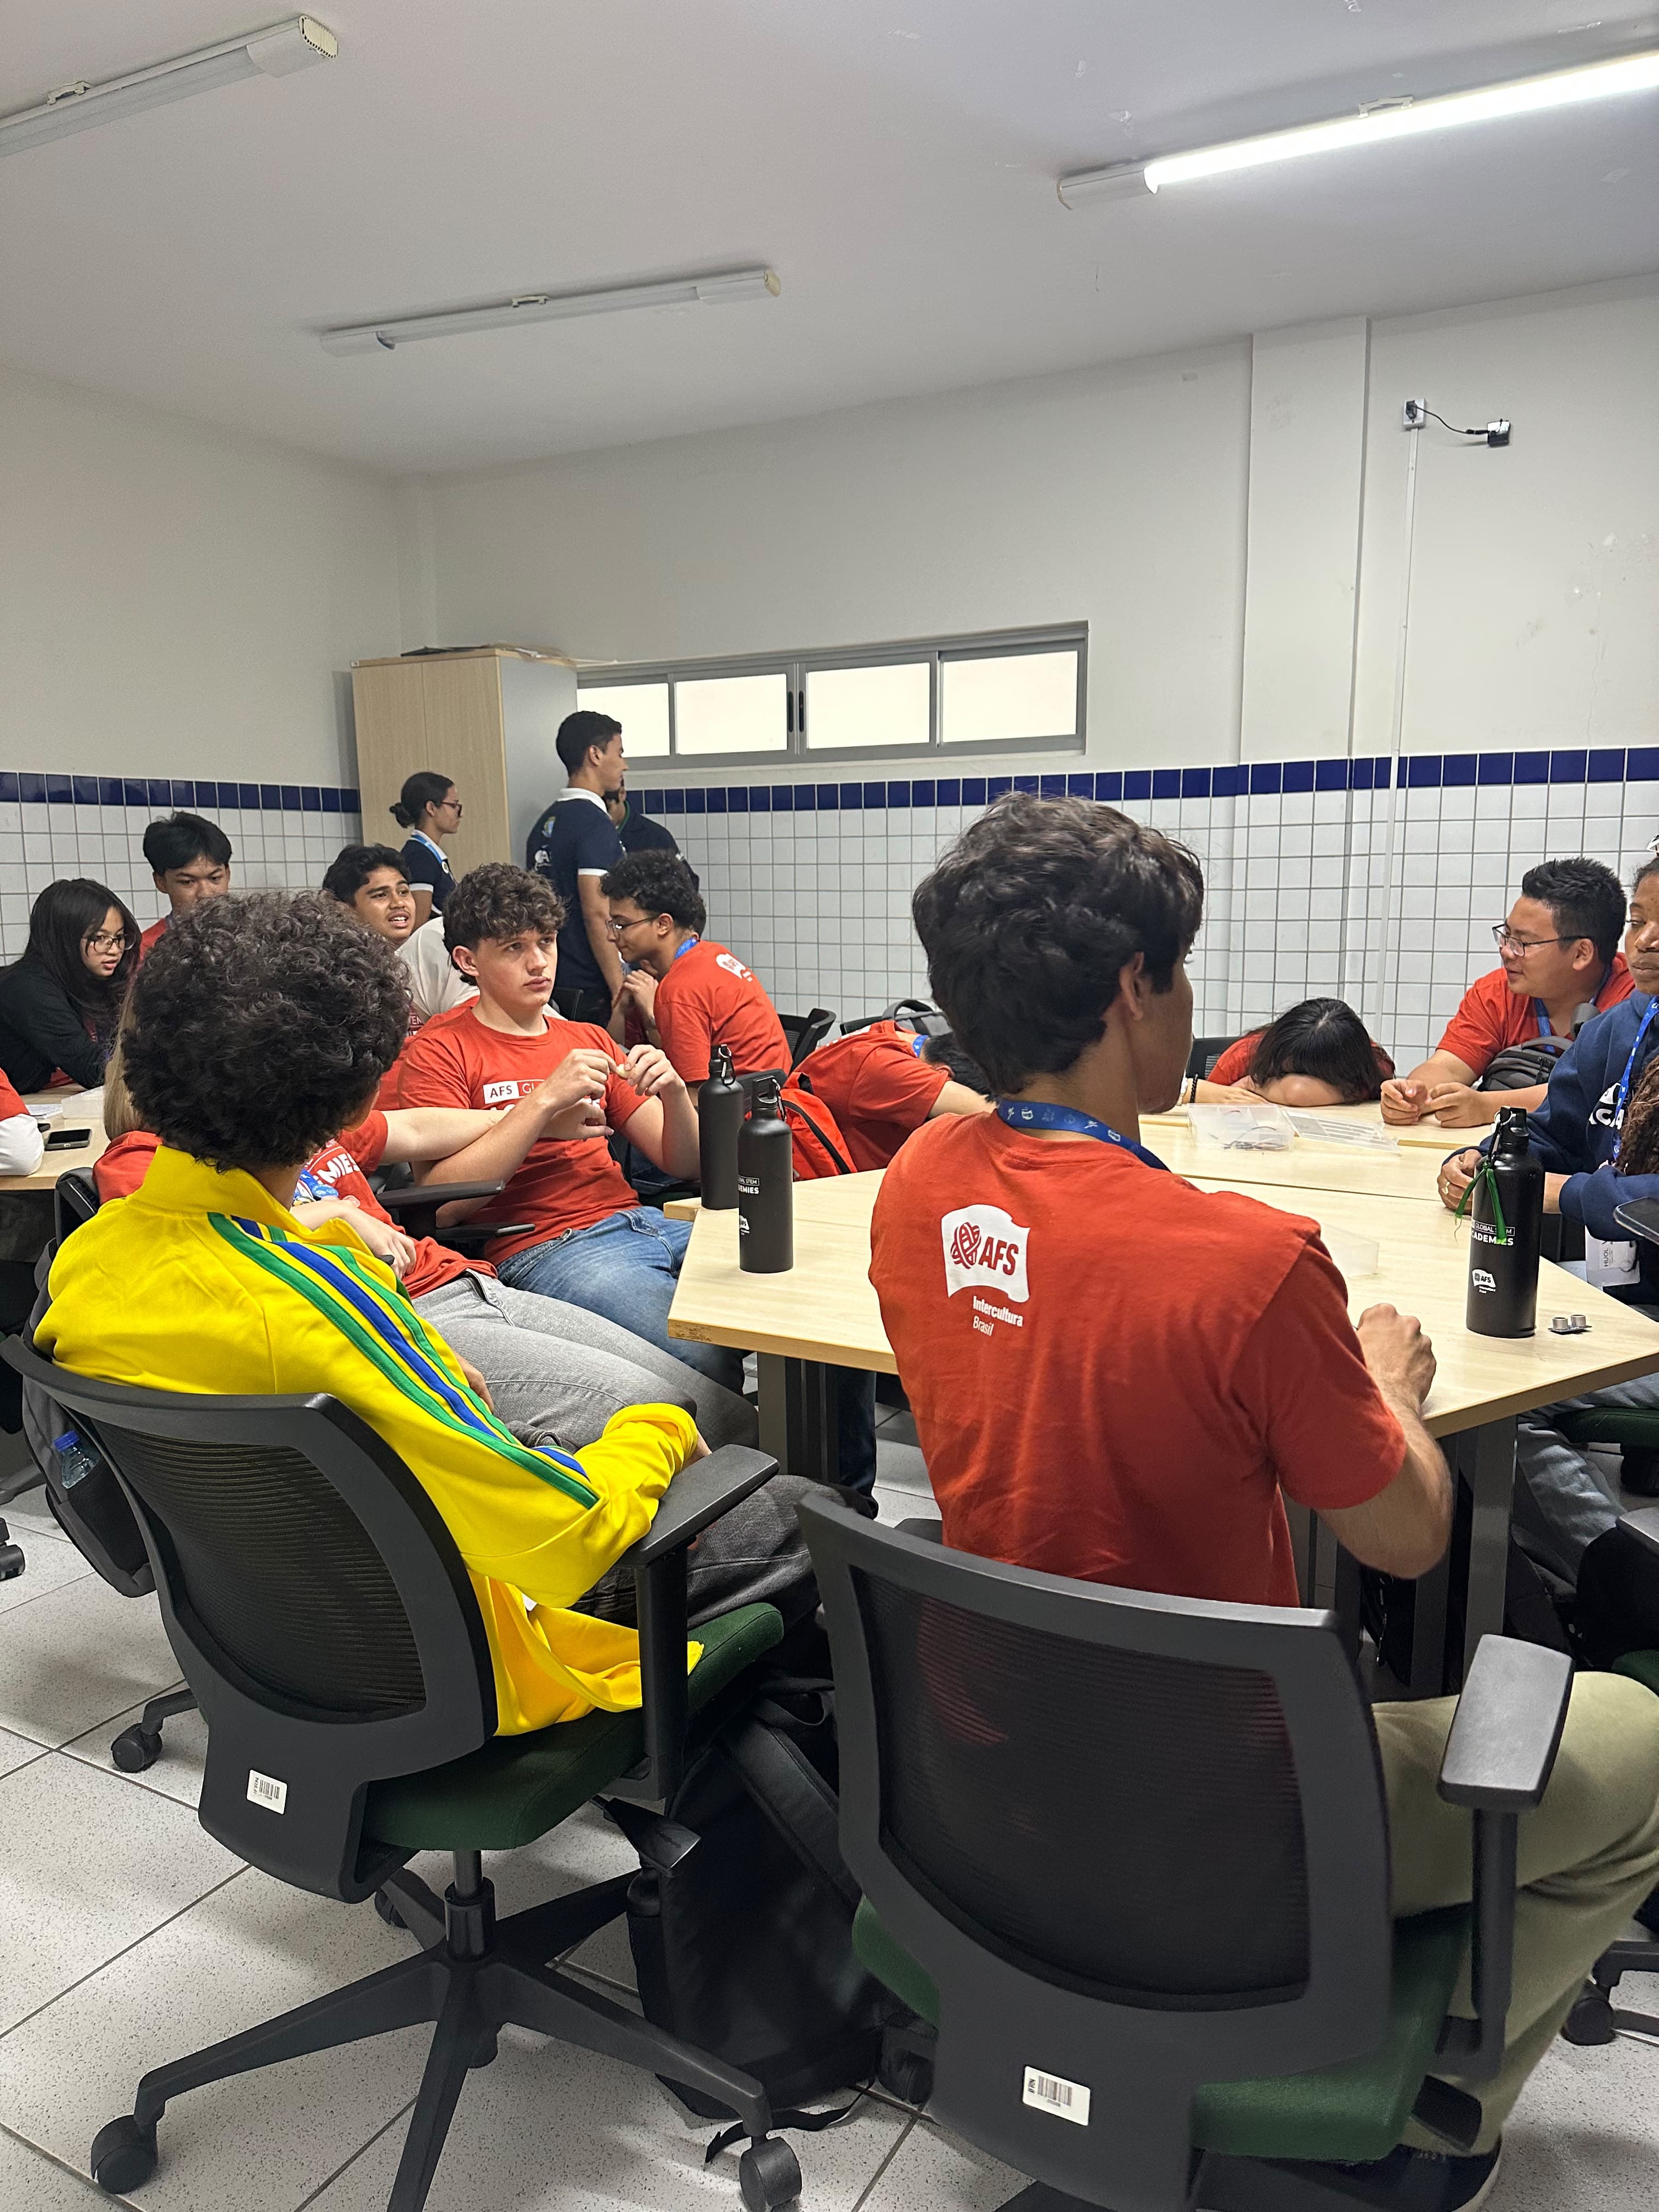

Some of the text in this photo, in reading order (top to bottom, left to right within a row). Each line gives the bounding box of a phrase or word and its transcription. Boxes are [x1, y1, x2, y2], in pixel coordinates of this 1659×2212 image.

[490, 1085, 512, 1098] AFS
[978, 1236, 1019, 1276] AFS
[973, 1295, 1024, 1327] Intercultura
[973, 1316, 994, 1336] Brasil
